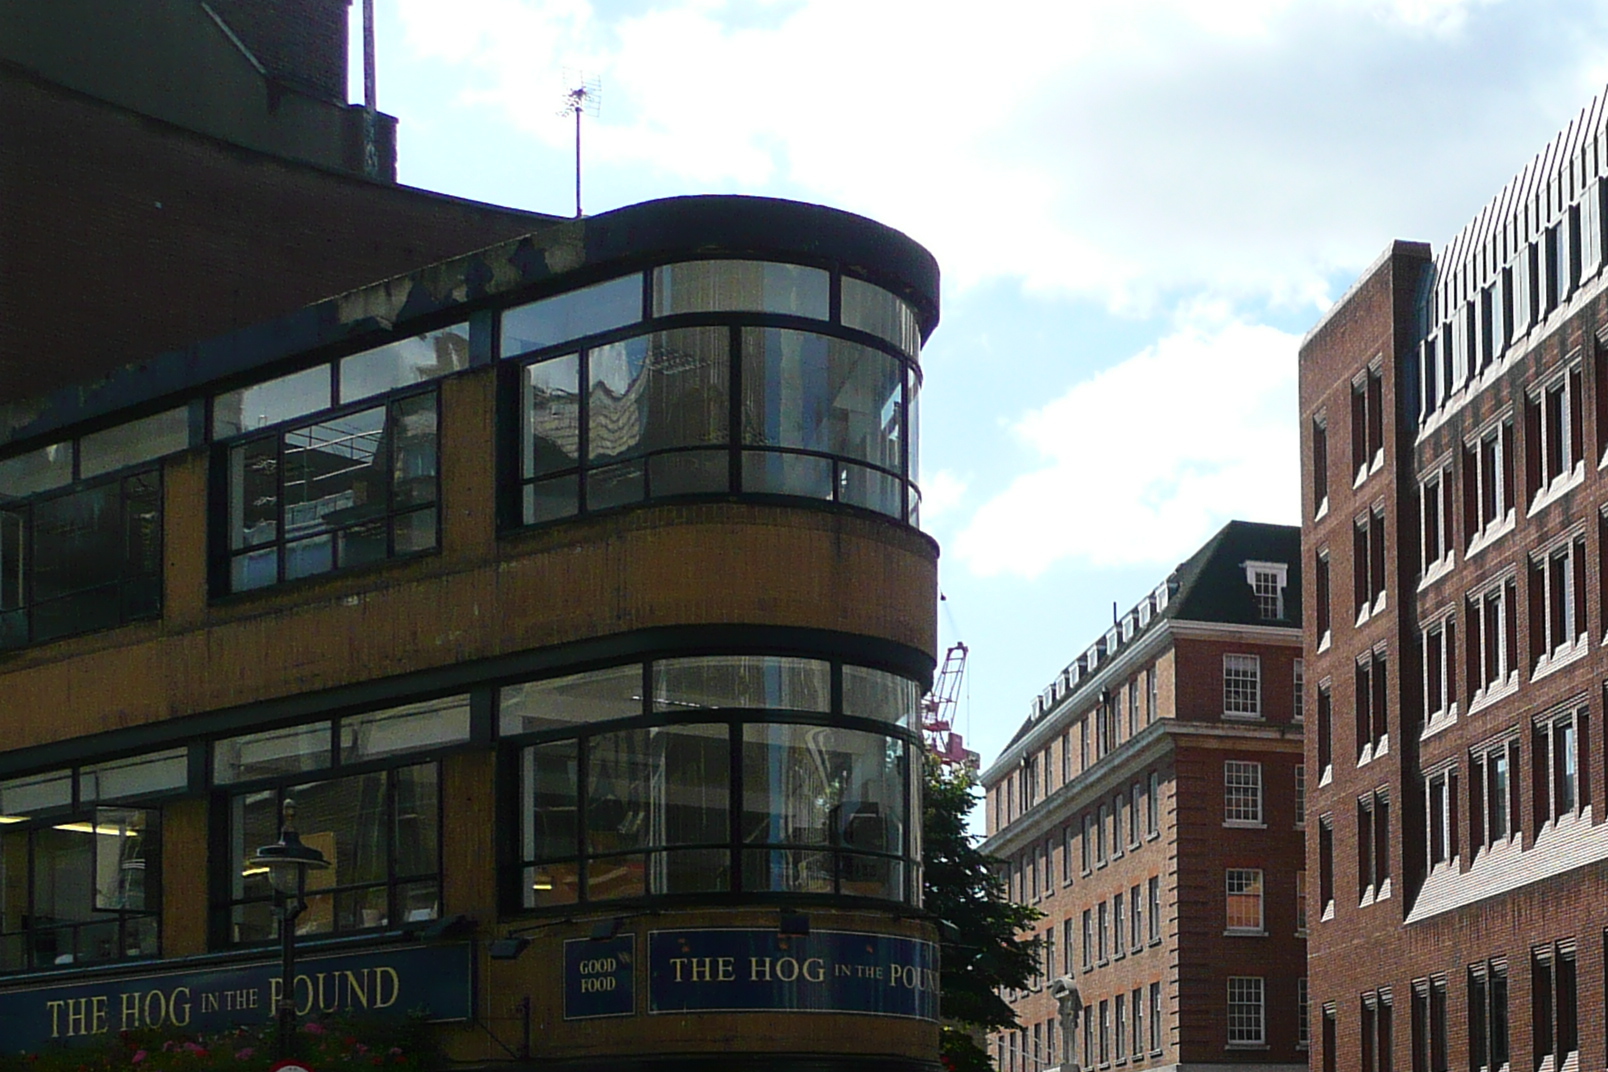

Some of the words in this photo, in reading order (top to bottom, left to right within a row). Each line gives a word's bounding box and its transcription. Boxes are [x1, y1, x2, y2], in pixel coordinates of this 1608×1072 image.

[579, 957, 617, 975] GOOD
[670, 956, 737, 983] THE
[748, 956, 827, 983] HOG
[834, 963, 851, 977] IN
[855, 964, 884, 979] THE
[580, 975, 617, 993] FOOD
[46, 995, 109, 1038] THE
[119, 986, 193, 1030] HOG
[201, 992, 221, 1014] IN
[224, 987, 260, 1011] THE
